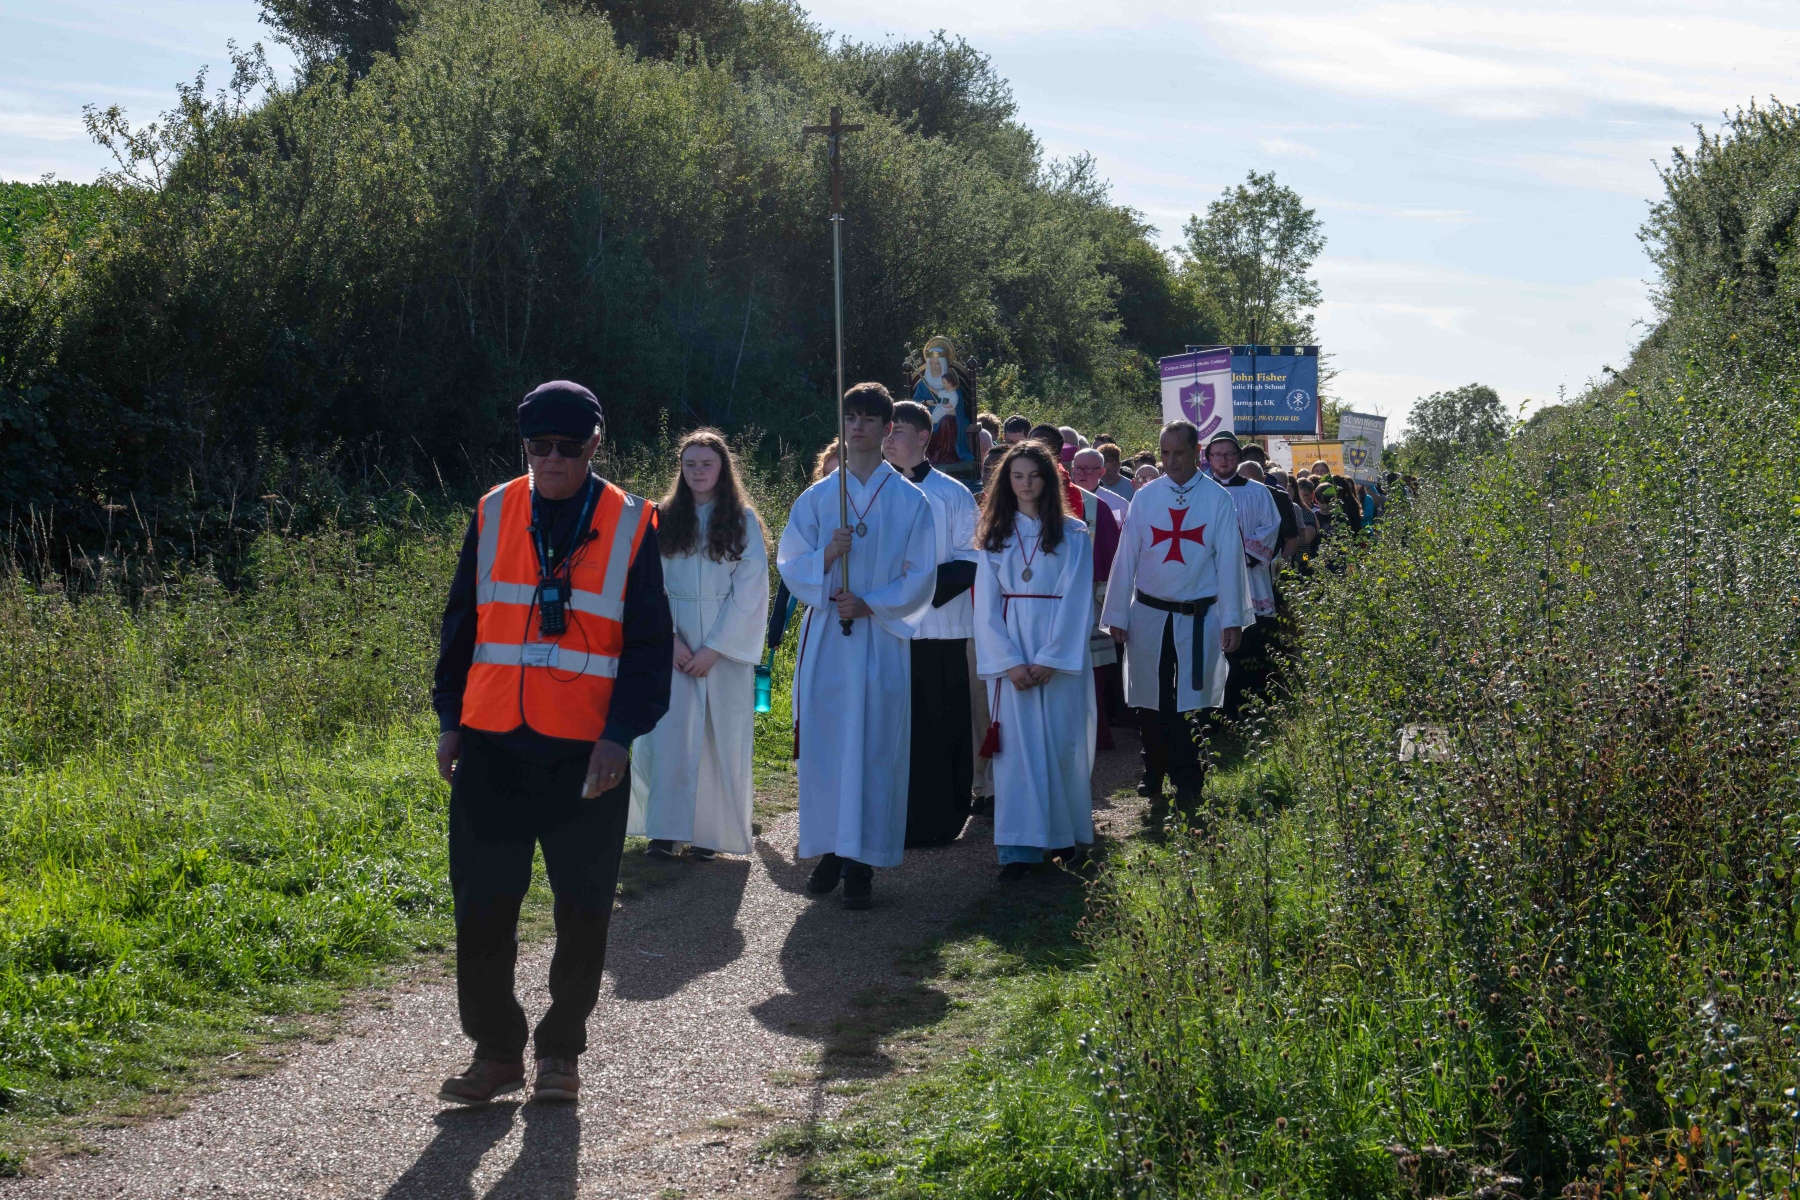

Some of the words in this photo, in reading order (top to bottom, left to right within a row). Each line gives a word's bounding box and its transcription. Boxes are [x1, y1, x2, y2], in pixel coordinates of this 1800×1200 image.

[1232, 372, 1254, 382] John
[1257, 373, 1286, 381] Fisher
[1354, 417, 1382, 428] Wilfrid's
[1200, 420, 1219, 437] CHRISTI
